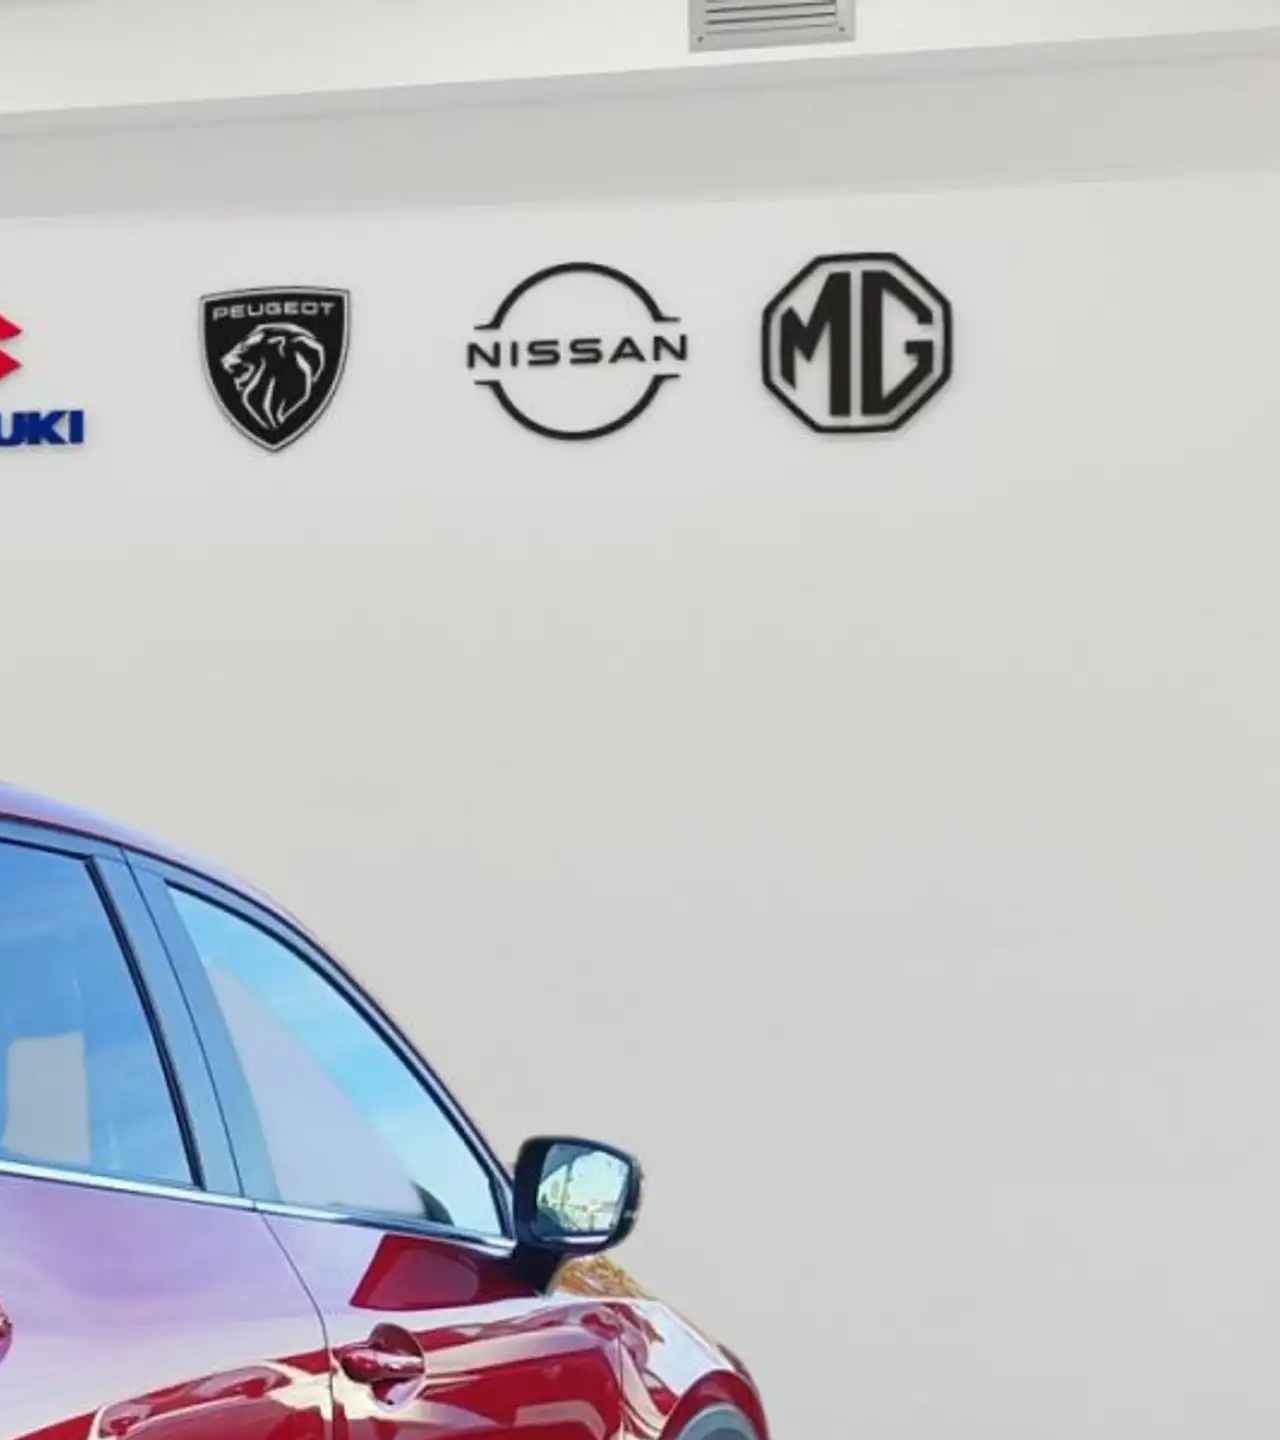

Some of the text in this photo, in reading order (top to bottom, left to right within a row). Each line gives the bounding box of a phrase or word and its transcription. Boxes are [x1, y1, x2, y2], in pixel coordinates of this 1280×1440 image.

[212, 300, 336, 321] PEUGEOT
[466, 333, 688, 370] NISSAN
[780, 268, 934, 418] MG
